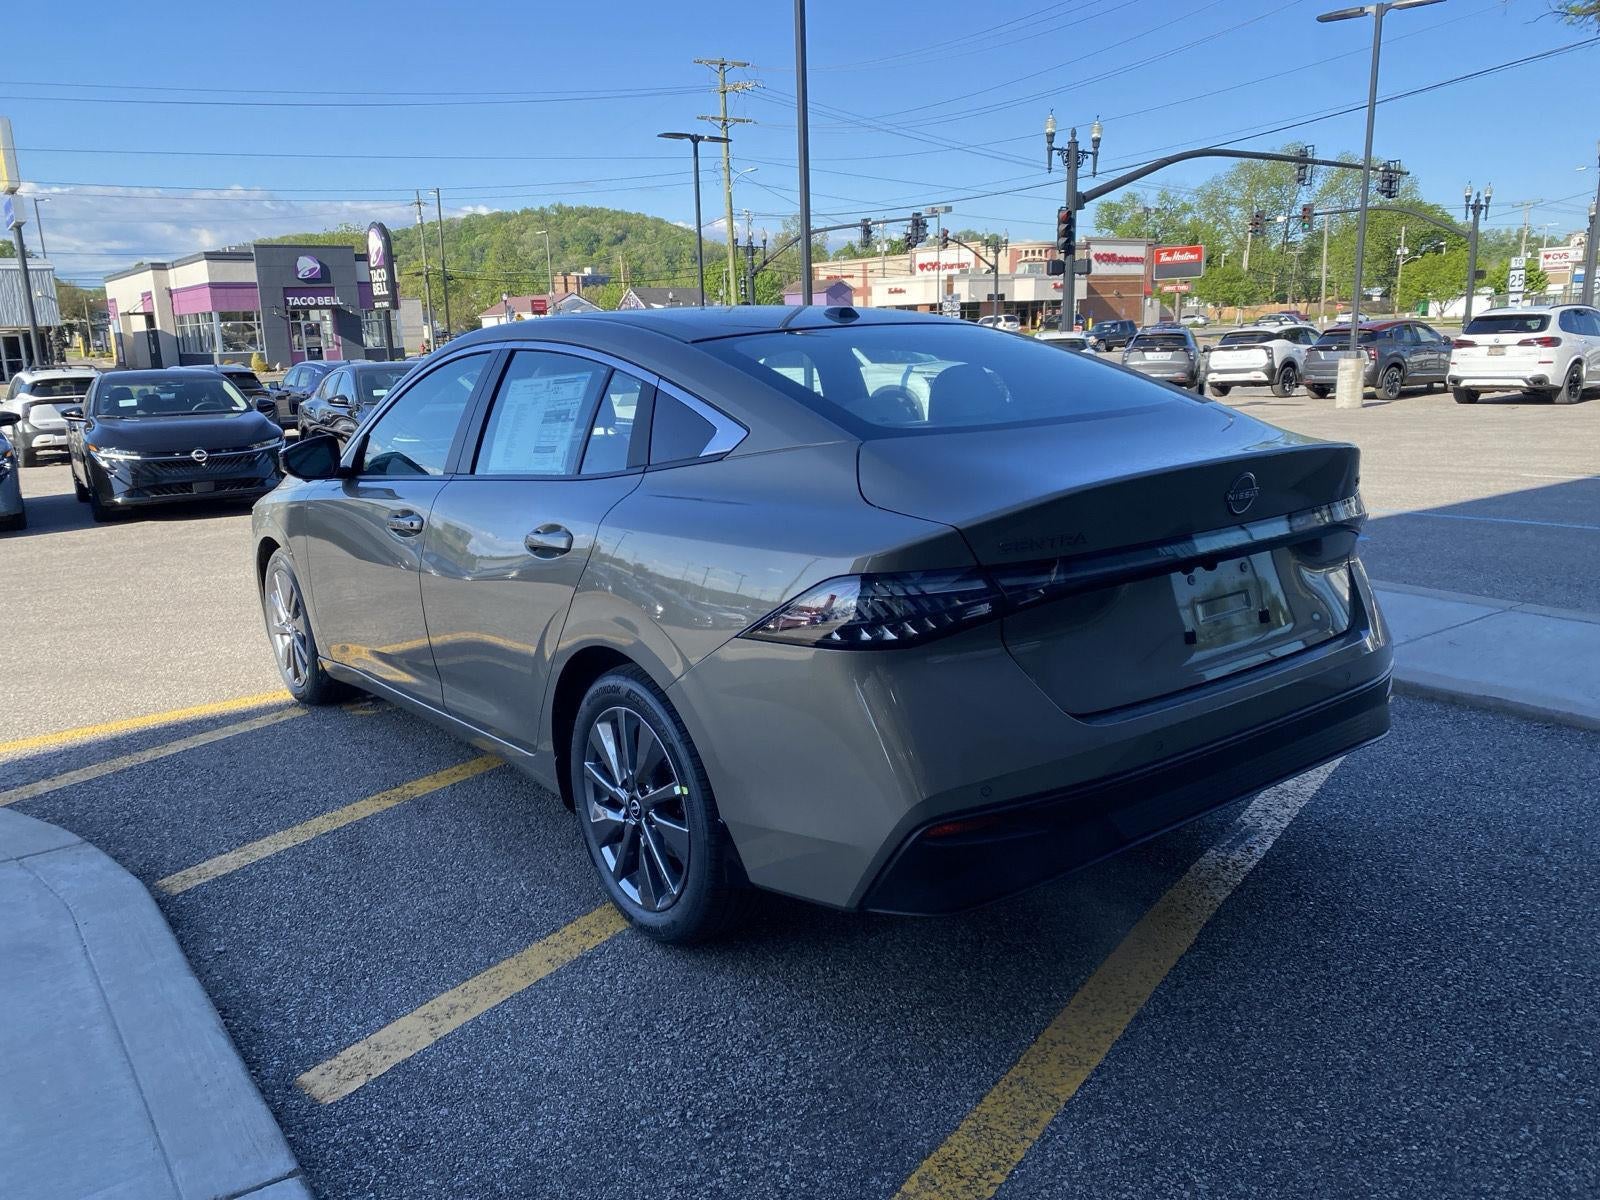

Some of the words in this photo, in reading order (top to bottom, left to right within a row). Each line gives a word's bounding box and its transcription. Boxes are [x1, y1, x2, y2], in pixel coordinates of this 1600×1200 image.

[1101, 252, 1117, 262] CVS
[1159, 252, 1173, 263] Tim
[1171, 251, 1198, 262] Hortons
[1552, 252, 1569, 260] CVS
[925, 261, 941, 272] CVS
[942, 261, 971, 271] pharmacy
[370, 268, 387, 282] TACO
[1509, 274, 1524, 288] 25
[372, 282, 389, 296] BELL
[286, 296, 318, 306] TACO
[318, 296, 344, 305] BELL
[1227, 487, 1259, 501] NISSAN
